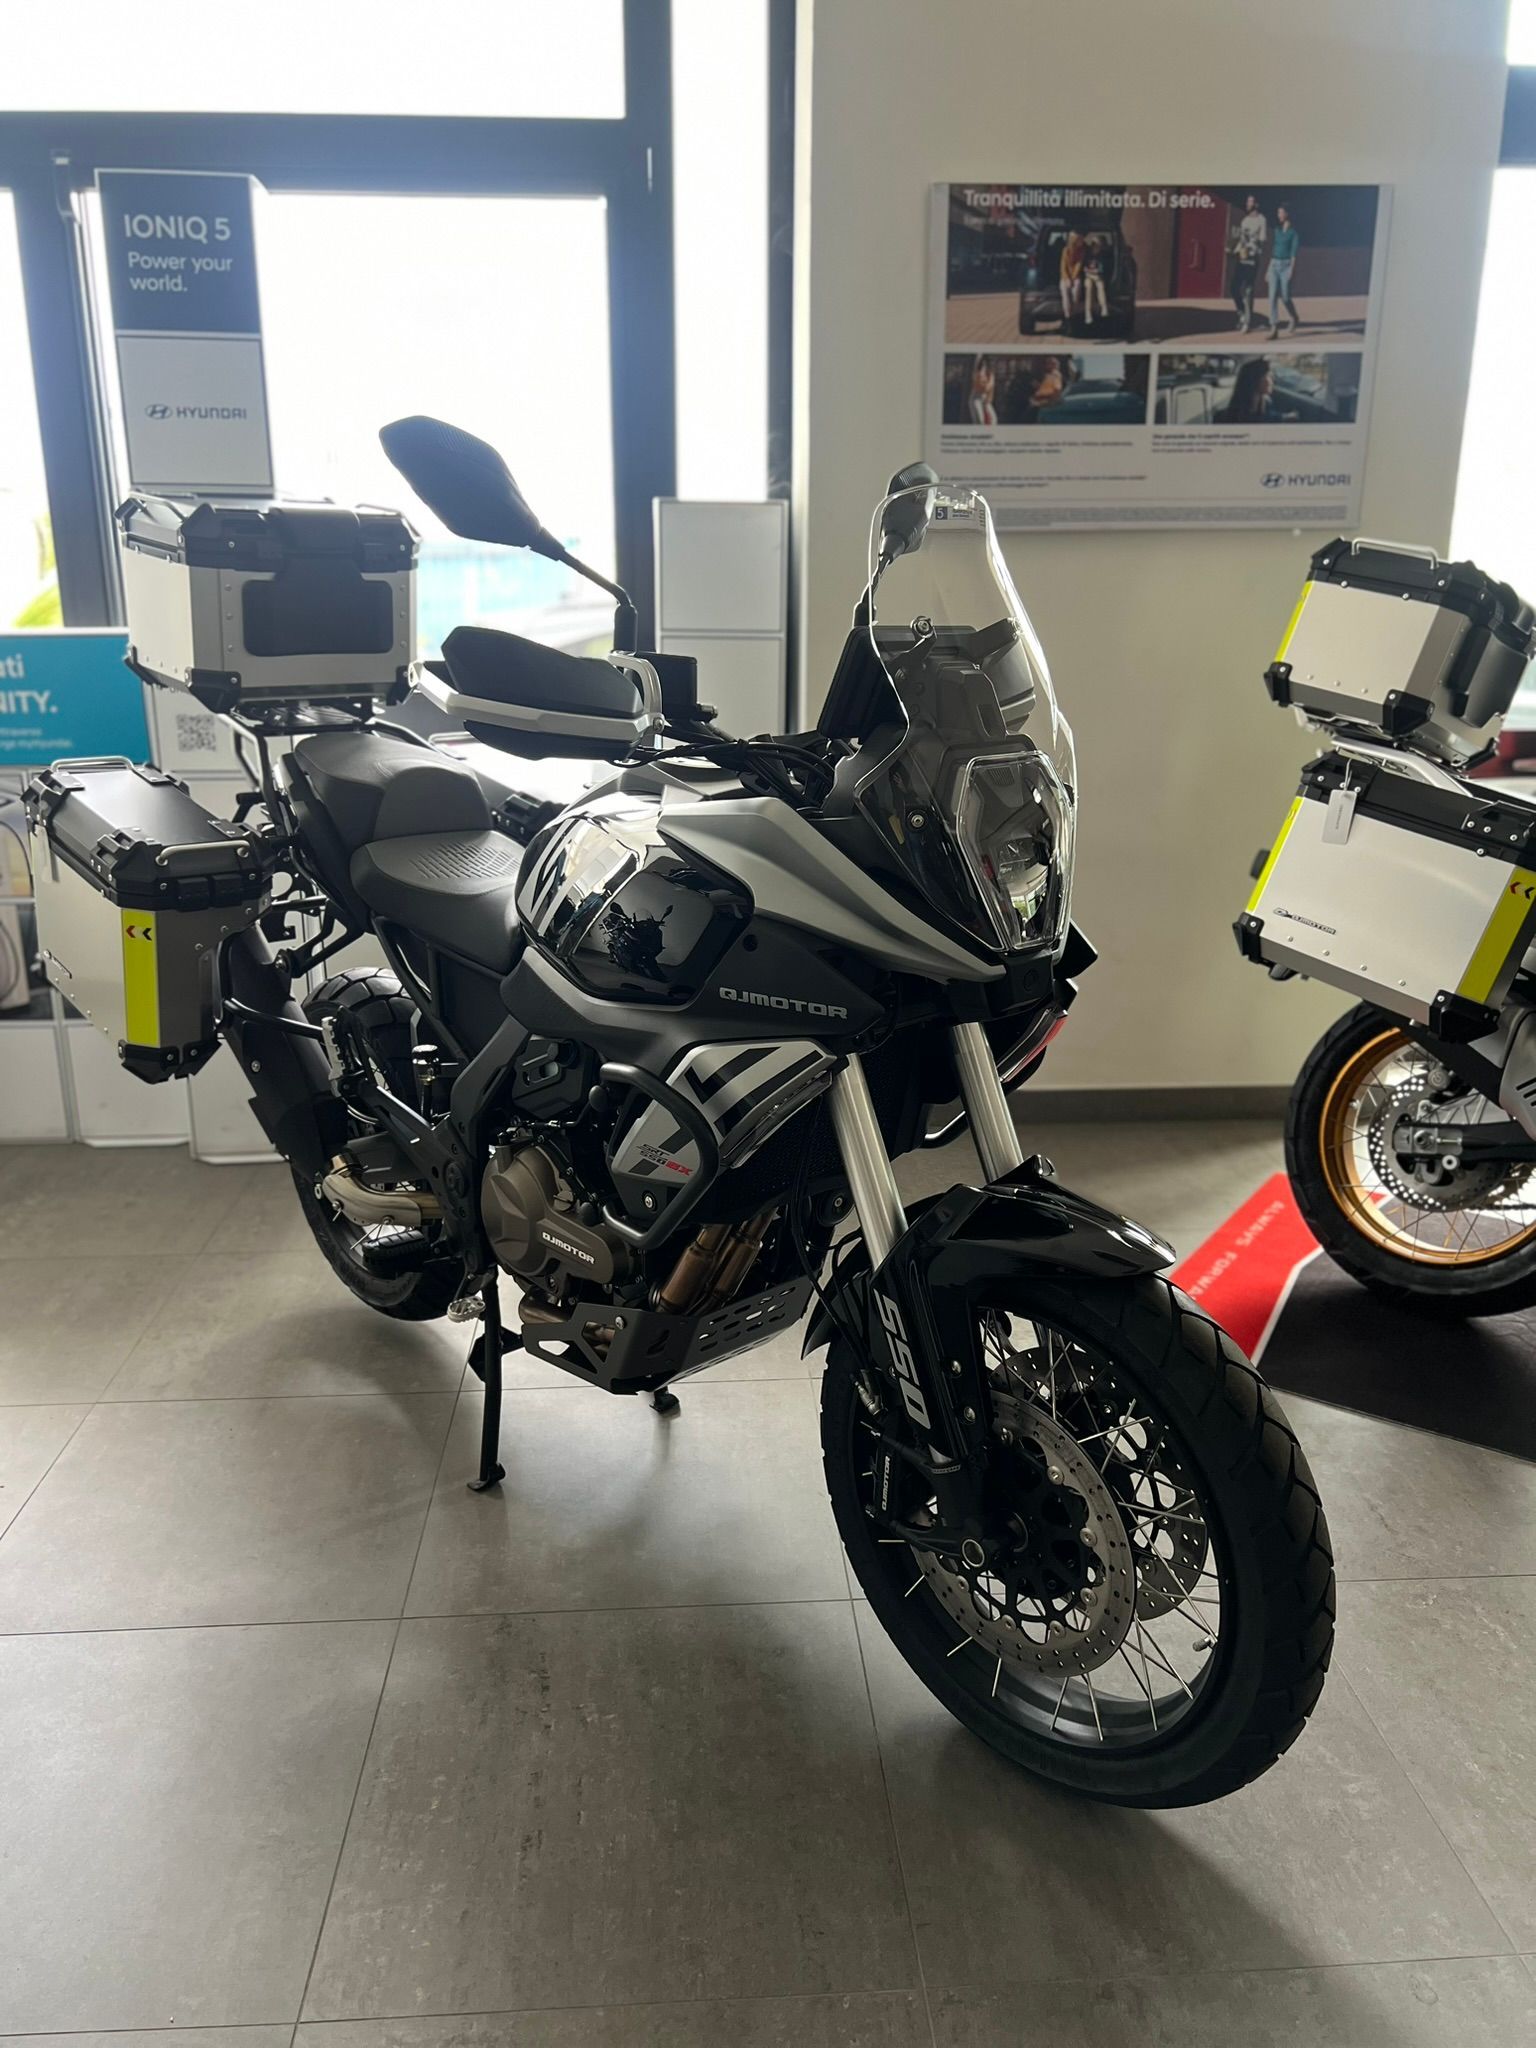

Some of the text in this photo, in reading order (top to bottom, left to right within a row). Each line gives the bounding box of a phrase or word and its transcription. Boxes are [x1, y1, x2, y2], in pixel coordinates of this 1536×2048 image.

[963, 189, 1215, 210] Tranquillità illimitata. Di serie.
[124, 214, 231, 244] IONIQ 5
[128, 251, 233, 274] Power your
[130, 275, 188, 292] world.
[176, 407, 247, 420] HYUNDAI
[1287, 473, 1351, 487] HYUNDAI
[719, 986, 848, 1019] QJMOTOR
[542, 1231, 595, 1264] QJMOTOR
[873, 1287, 932, 1430] 550
[881, 1455, 891, 1511] QJMOTOR
